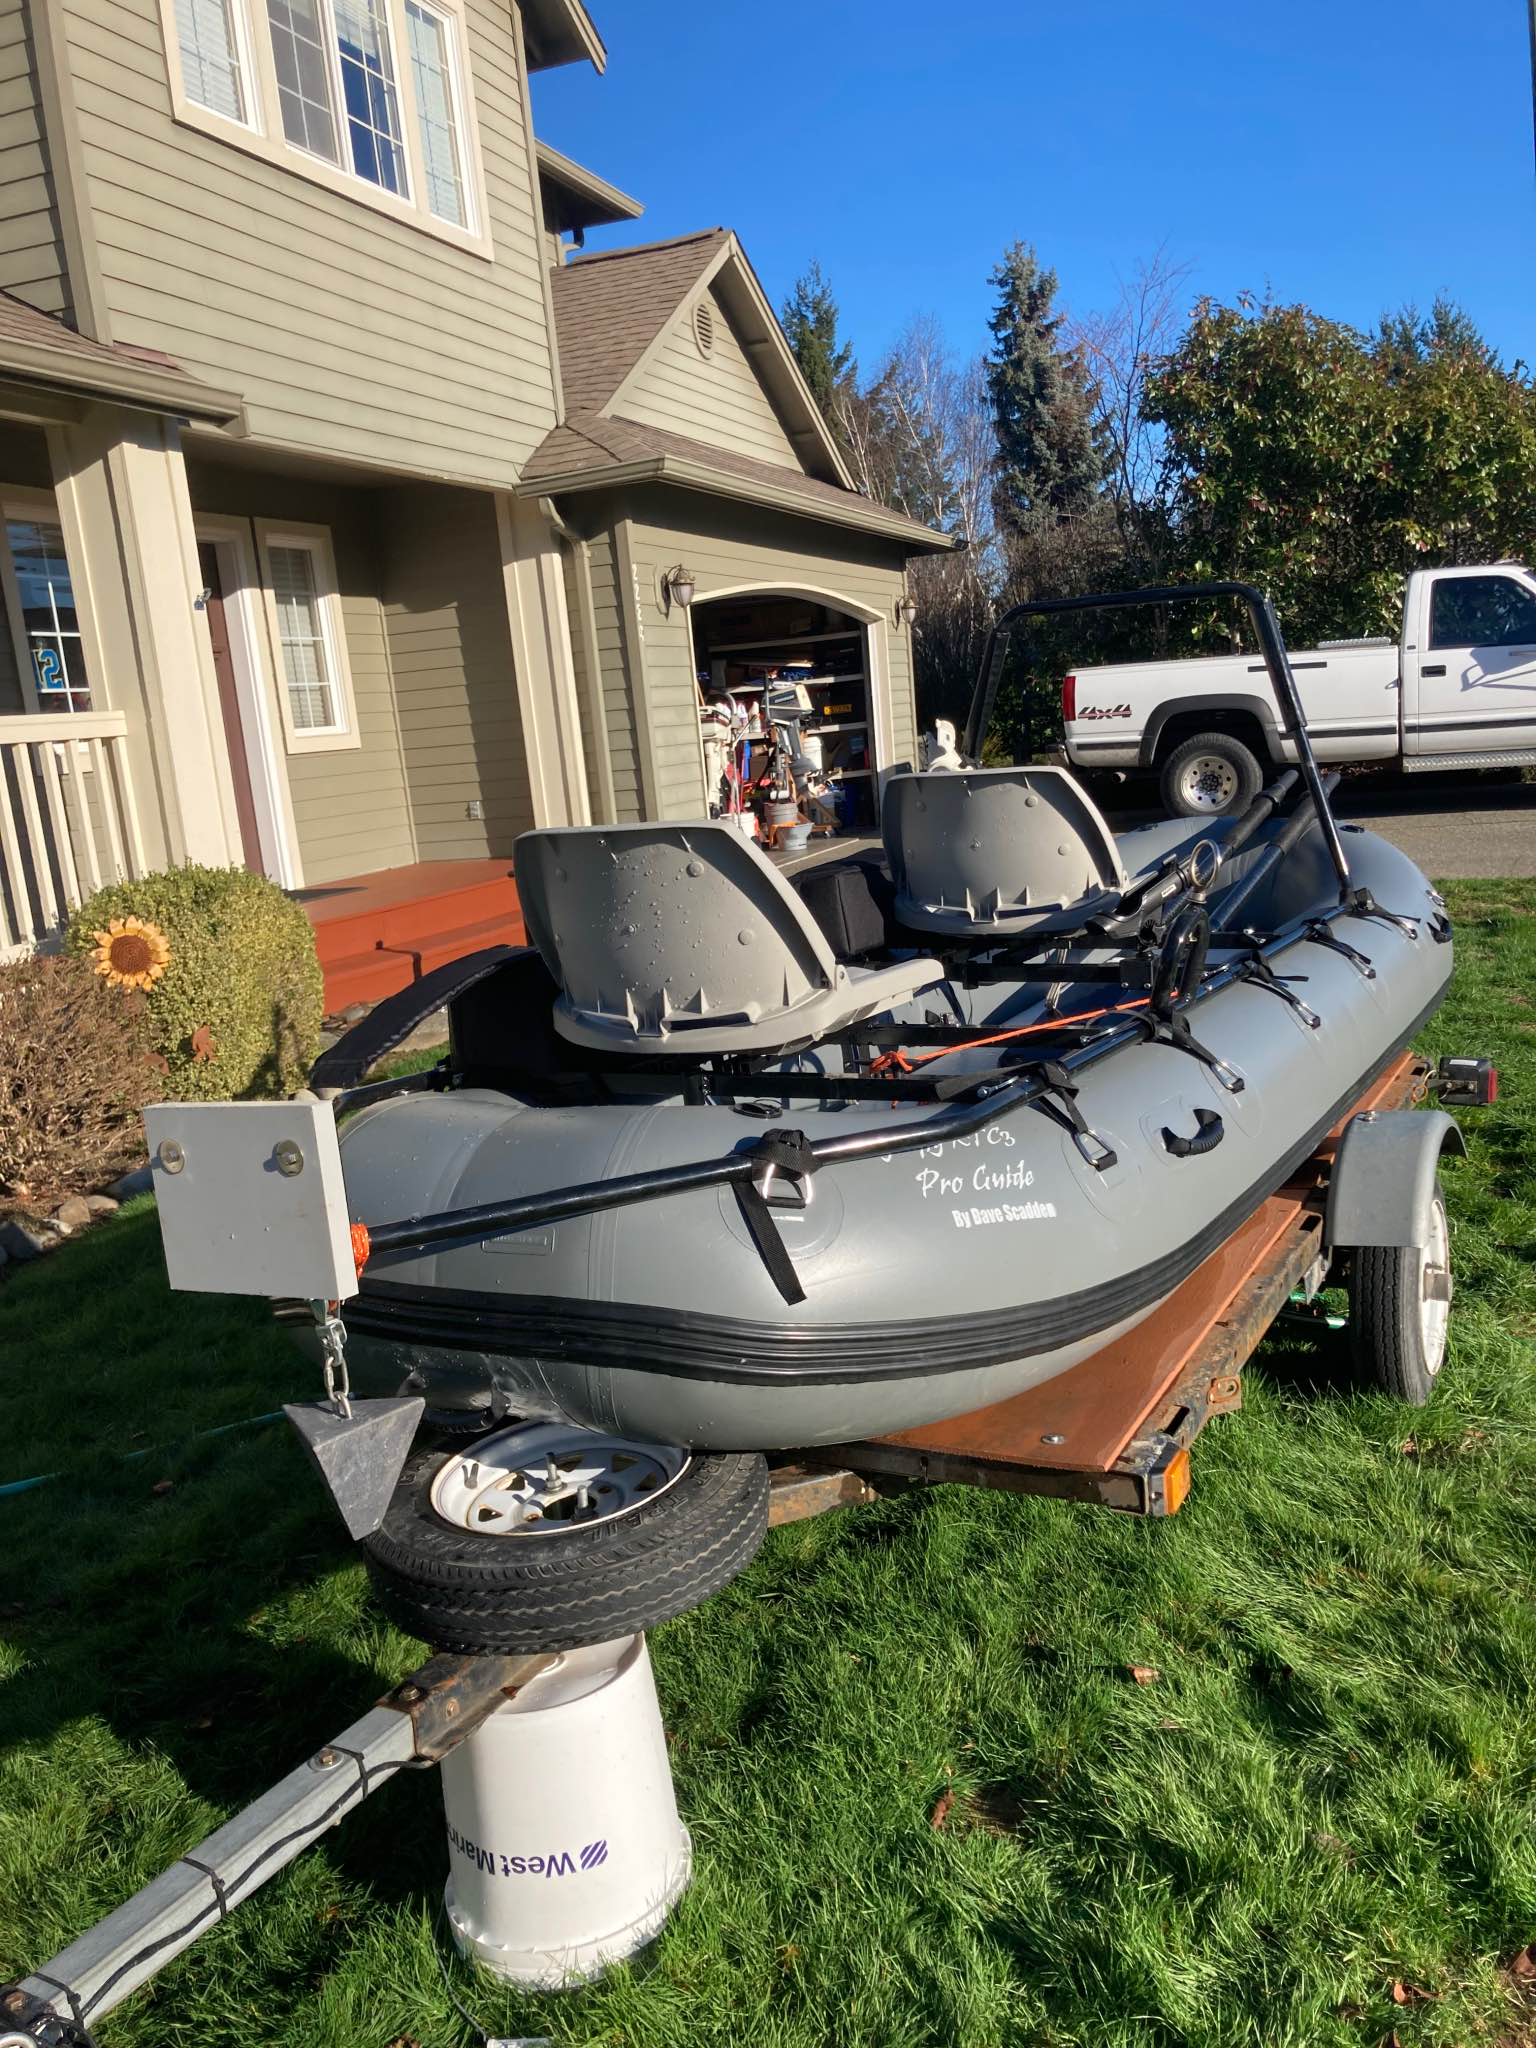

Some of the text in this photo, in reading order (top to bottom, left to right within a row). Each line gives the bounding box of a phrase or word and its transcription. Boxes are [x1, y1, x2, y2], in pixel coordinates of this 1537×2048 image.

[1077, 703, 1133, 721] 4x4
[915, 1160, 1034, 1199] Pro Guide
[952, 1200, 1057, 1229] By Dave Scadden
[448, 1824, 577, 1879] West Marin
